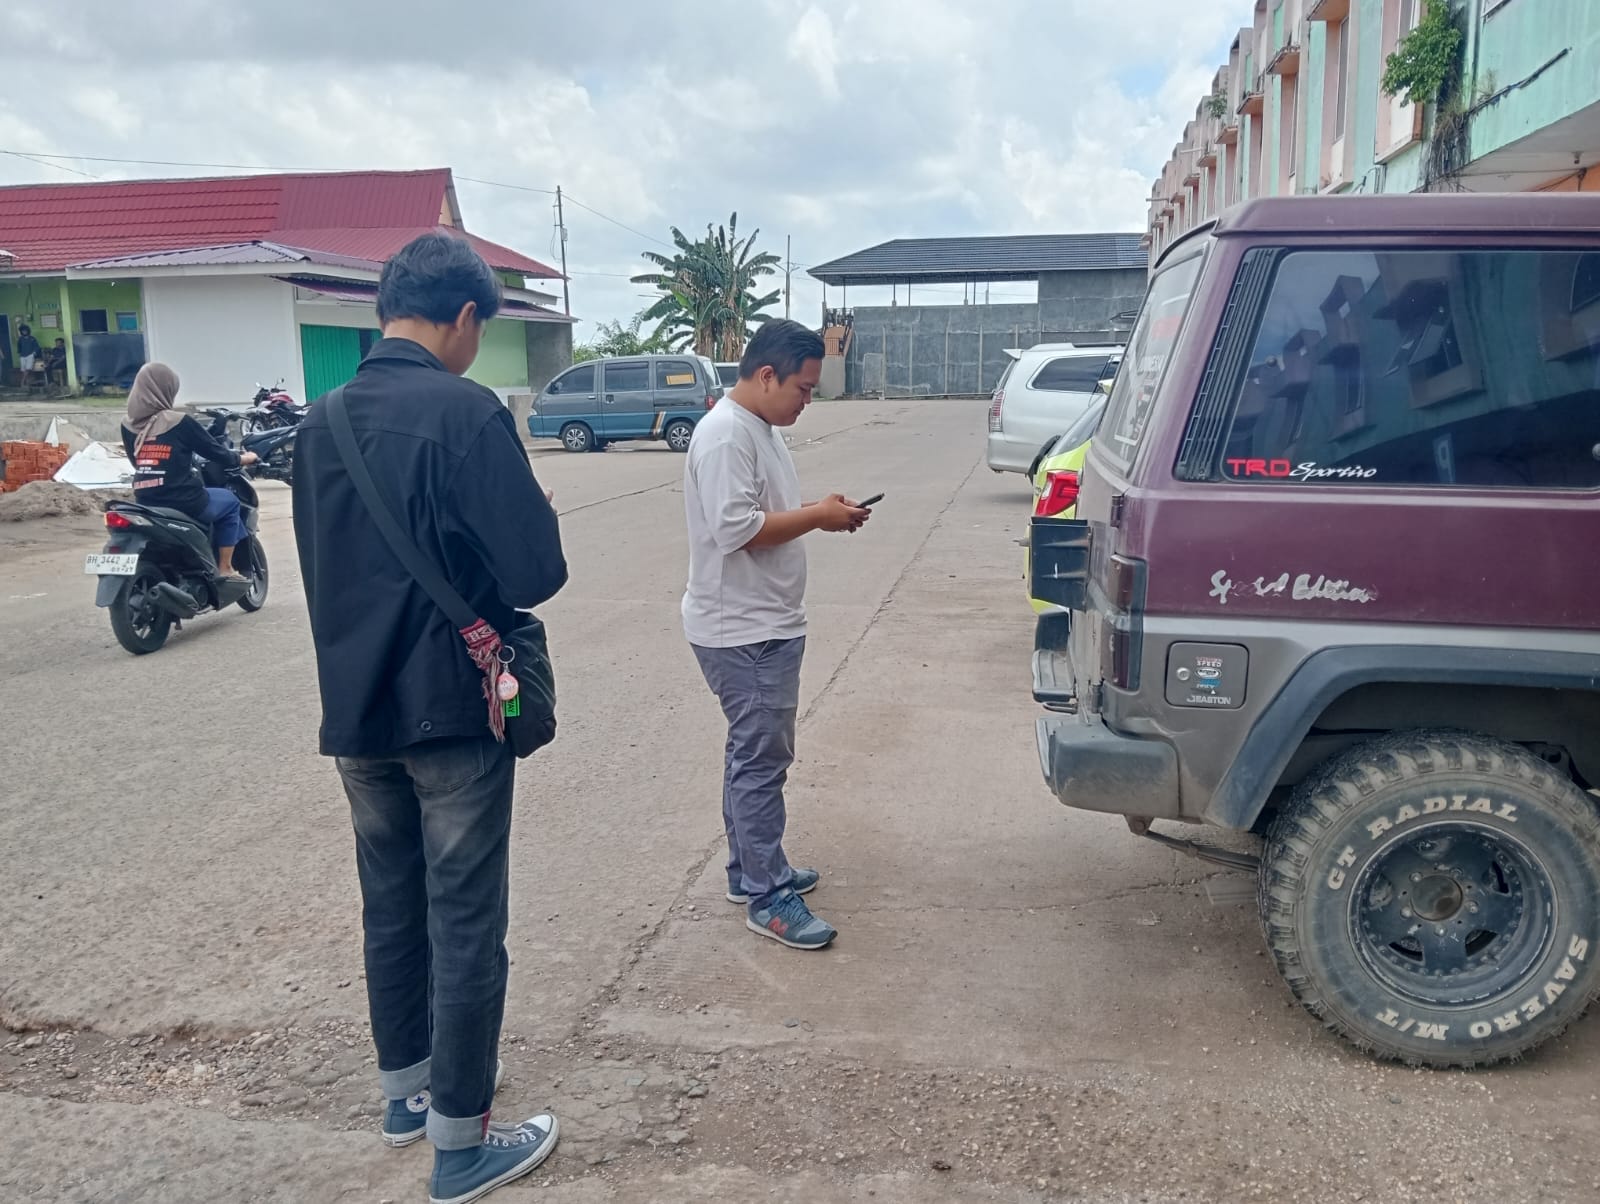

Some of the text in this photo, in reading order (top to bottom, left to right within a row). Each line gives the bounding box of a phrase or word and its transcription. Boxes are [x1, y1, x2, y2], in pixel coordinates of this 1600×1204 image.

[1226, 457, 1290, 477] TRD
[1328, 795, 1518, 889] GT RADIAL
[1375, 934, 1588, 1041] SAVERO M/T
